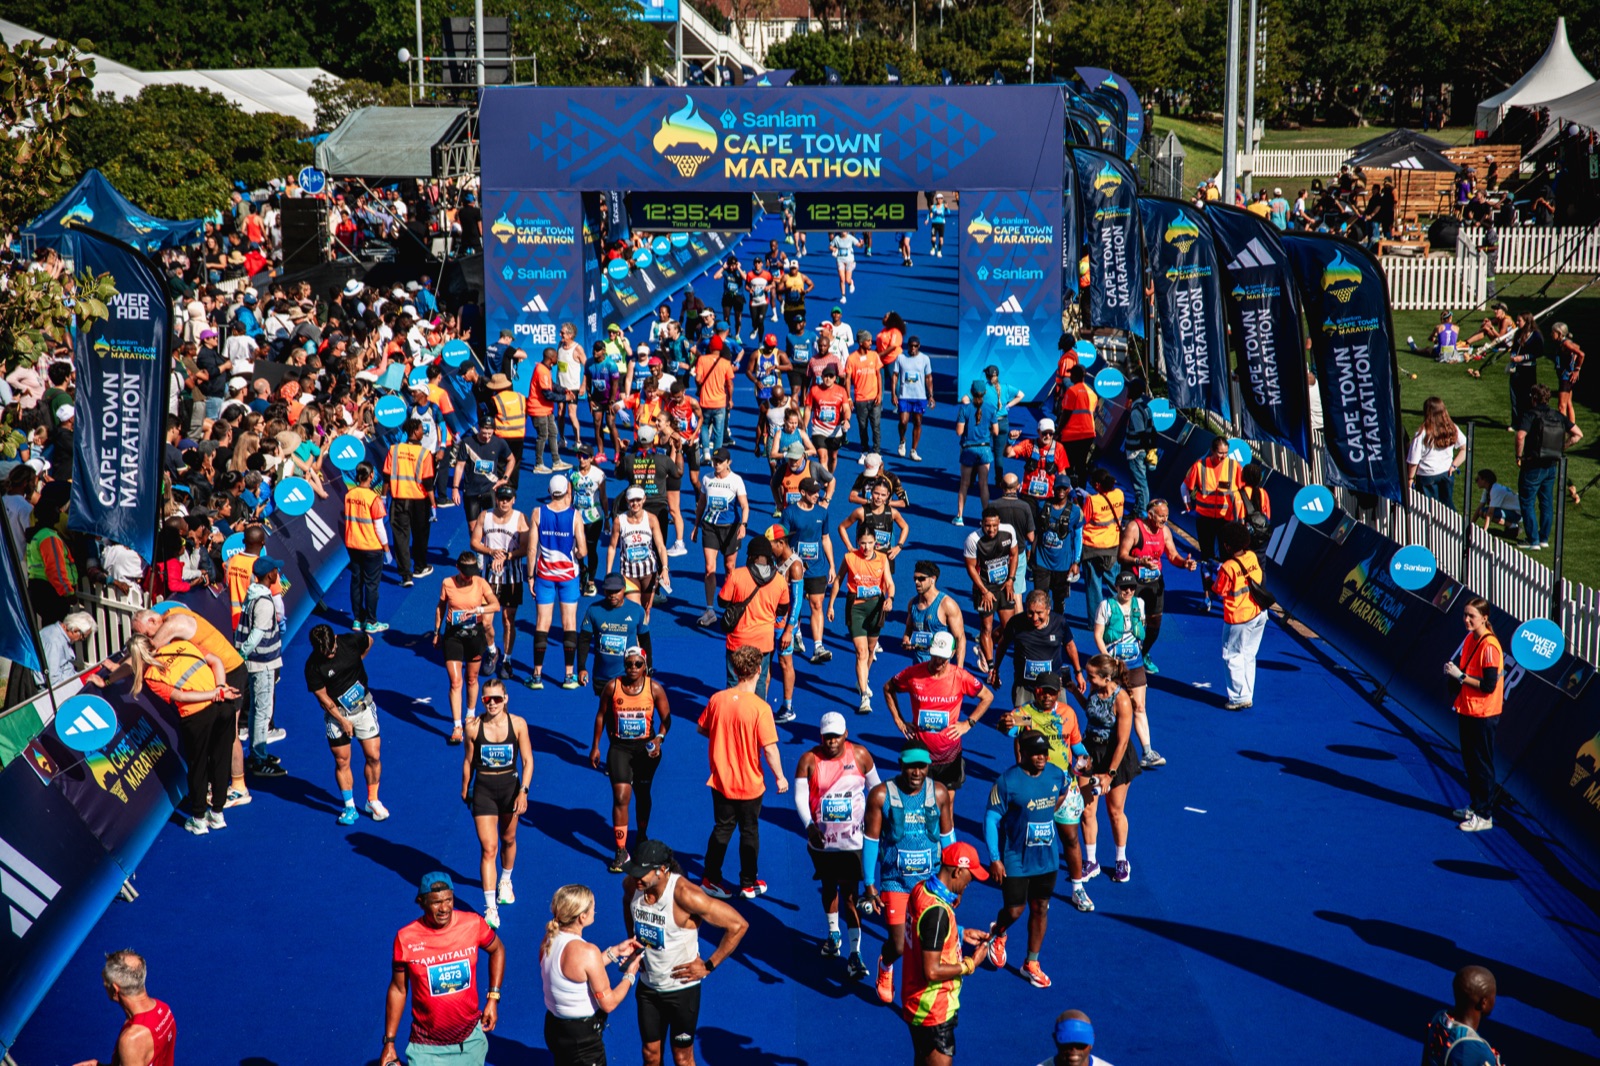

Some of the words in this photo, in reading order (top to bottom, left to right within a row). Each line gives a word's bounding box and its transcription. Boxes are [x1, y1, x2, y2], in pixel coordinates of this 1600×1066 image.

[743, 111, 815, 128] Sanlam
[724, 134, 792, 154] CAPE
[801, 133, 882, 153] TOWN
[724, 158, 882, 178] MARATHON
[643, 204, 740, 221] 12:35:48
[807, 204, 903, 220] 12:35:48
[994, 226, 1020, 234] CAPE
[1023, 226, 1053, 234] TOWN
[517, 236, 574, 244] MARATHON
[994, 235, 1052, 244] MARATHON
[1101, 227, 1113, 268] TOWN
[518, 267, 566, 279] Sanlam
[993, 268, 1043, 279] Sanlam
[1112, 225, 1130, 307] MARATHON
[1105, 268, 1117, 308] CAPE
[107, 293, 149, 306] WER
[117, 306, 149, 319] ADE
[1176, 290, 1192, 343] TOWN
[514, 324, 556, 334] POWER
[987, 326, 1030, 336] POWER
[1338, 322, 1357, 330] CAPE
[1358, 317, 1379, 327] TOWN
[1339, 324, 1380, 336] MARATHON
[533, 334, 556, 344] ADE
[1006, 336, 1030, 346] ADE
[1190, 287, 1210, 385] MARATHON
[1242, 310, 1259, 361] TOWN
[1184, 343, 1196, 387] CAPE
[1258, 308, 1282, 406] MARATHON
[1334, 347, 1358, 407] TOWN
[1249, 366, 1265, 406] CAPE
[102, 372, 119, 440] TOWN
[384, 407, 404, 415] Sanlam
[1352, 344, 1383, 462] MARATHON
[120, 372, 140, 507] MARATHON
[1344, 410, 1365, 464] CAPE
[98, 447, 117, 506] CAPE
[632, 534, 643, 542] 35
[1403, 563, 1432, 573] Sanlam
[1361, 581, 1381, 605] CAPE
[1380, 594, 1406, 620] TOWN
[1348, 596, 1395, 637] MARATHON
[1521, 630, 1557, 650] POWER
[1532, 645, 1551, 659] ADE
[924, 716, 943, 724] 12074
[110, 735, 137, 771] CAPE
[131, 716, 153, 749] TOWN
[125, 737, 167, 791] MARATHON
[635, 909, 665, 925] CHRISTOPHER
[640, 928, 657, 939] 8352
[436, 947, 477, 964] VITALITY
[439, 970, 462, 981] 4873
